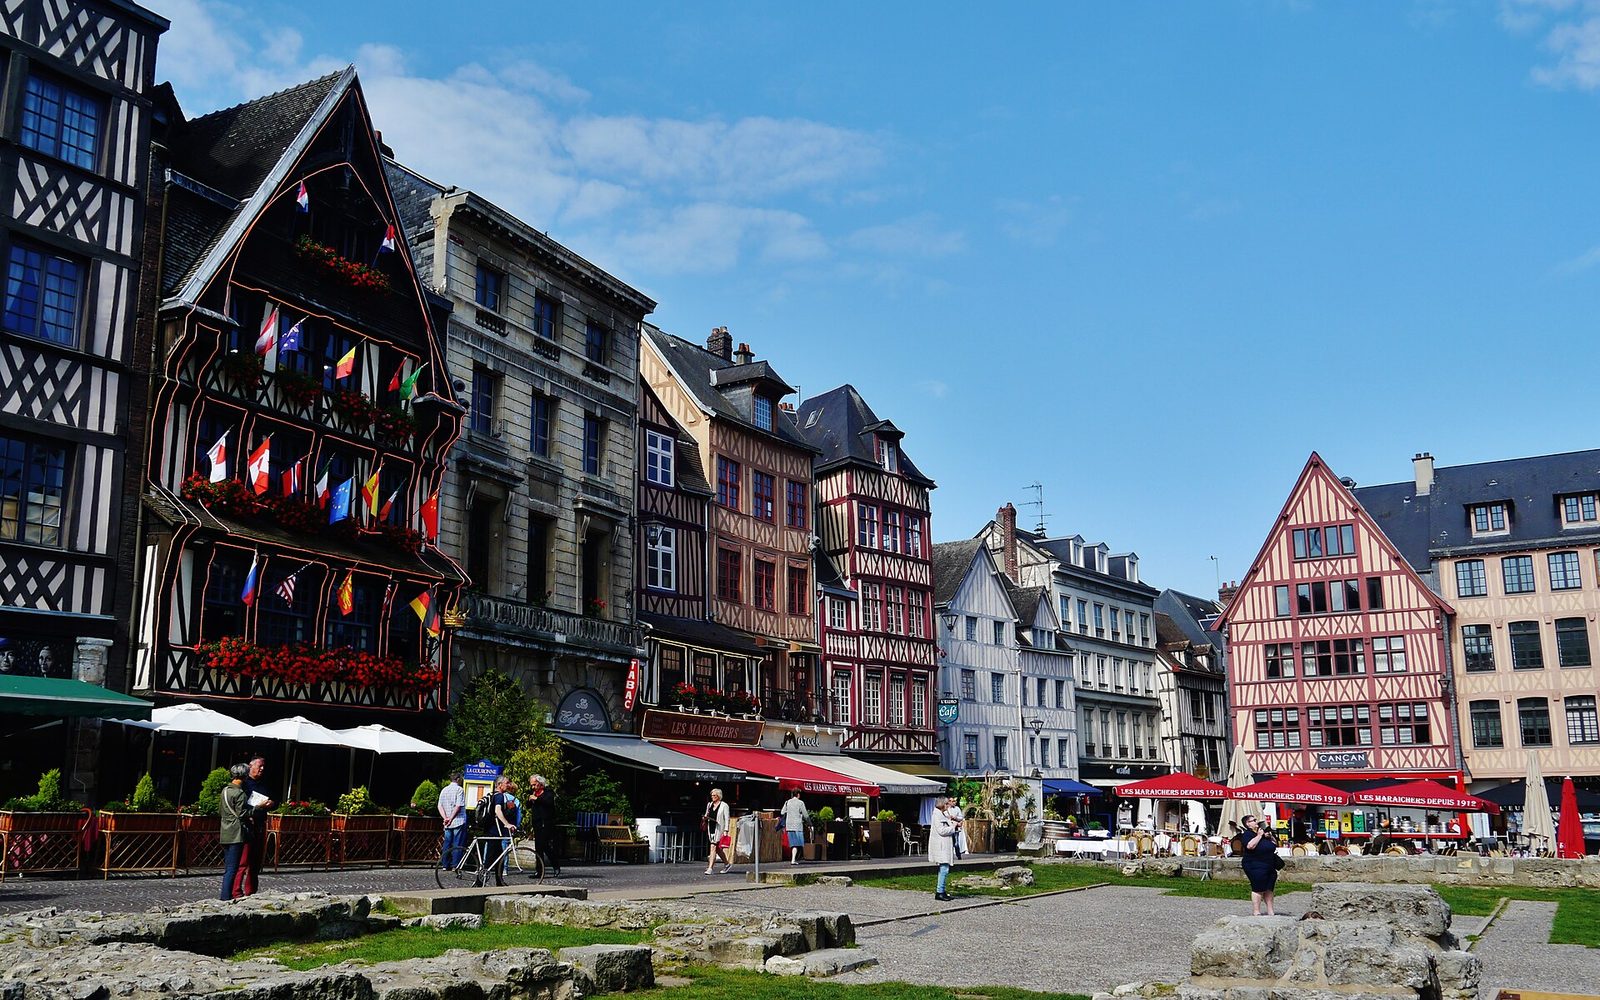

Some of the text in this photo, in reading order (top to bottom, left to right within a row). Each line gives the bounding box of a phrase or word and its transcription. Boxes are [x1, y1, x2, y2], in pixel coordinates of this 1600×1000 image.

[625, 661, 636, 708] TABAC
[939, 706, 956, 718] Café
[671, 722, 687, 735] LES
[688, 723, 740, 739] MARAICHERS
[1247, 792, 1295, 800] MARAICHERS
[1374, 795, 1426, 804] MARAICHERS
